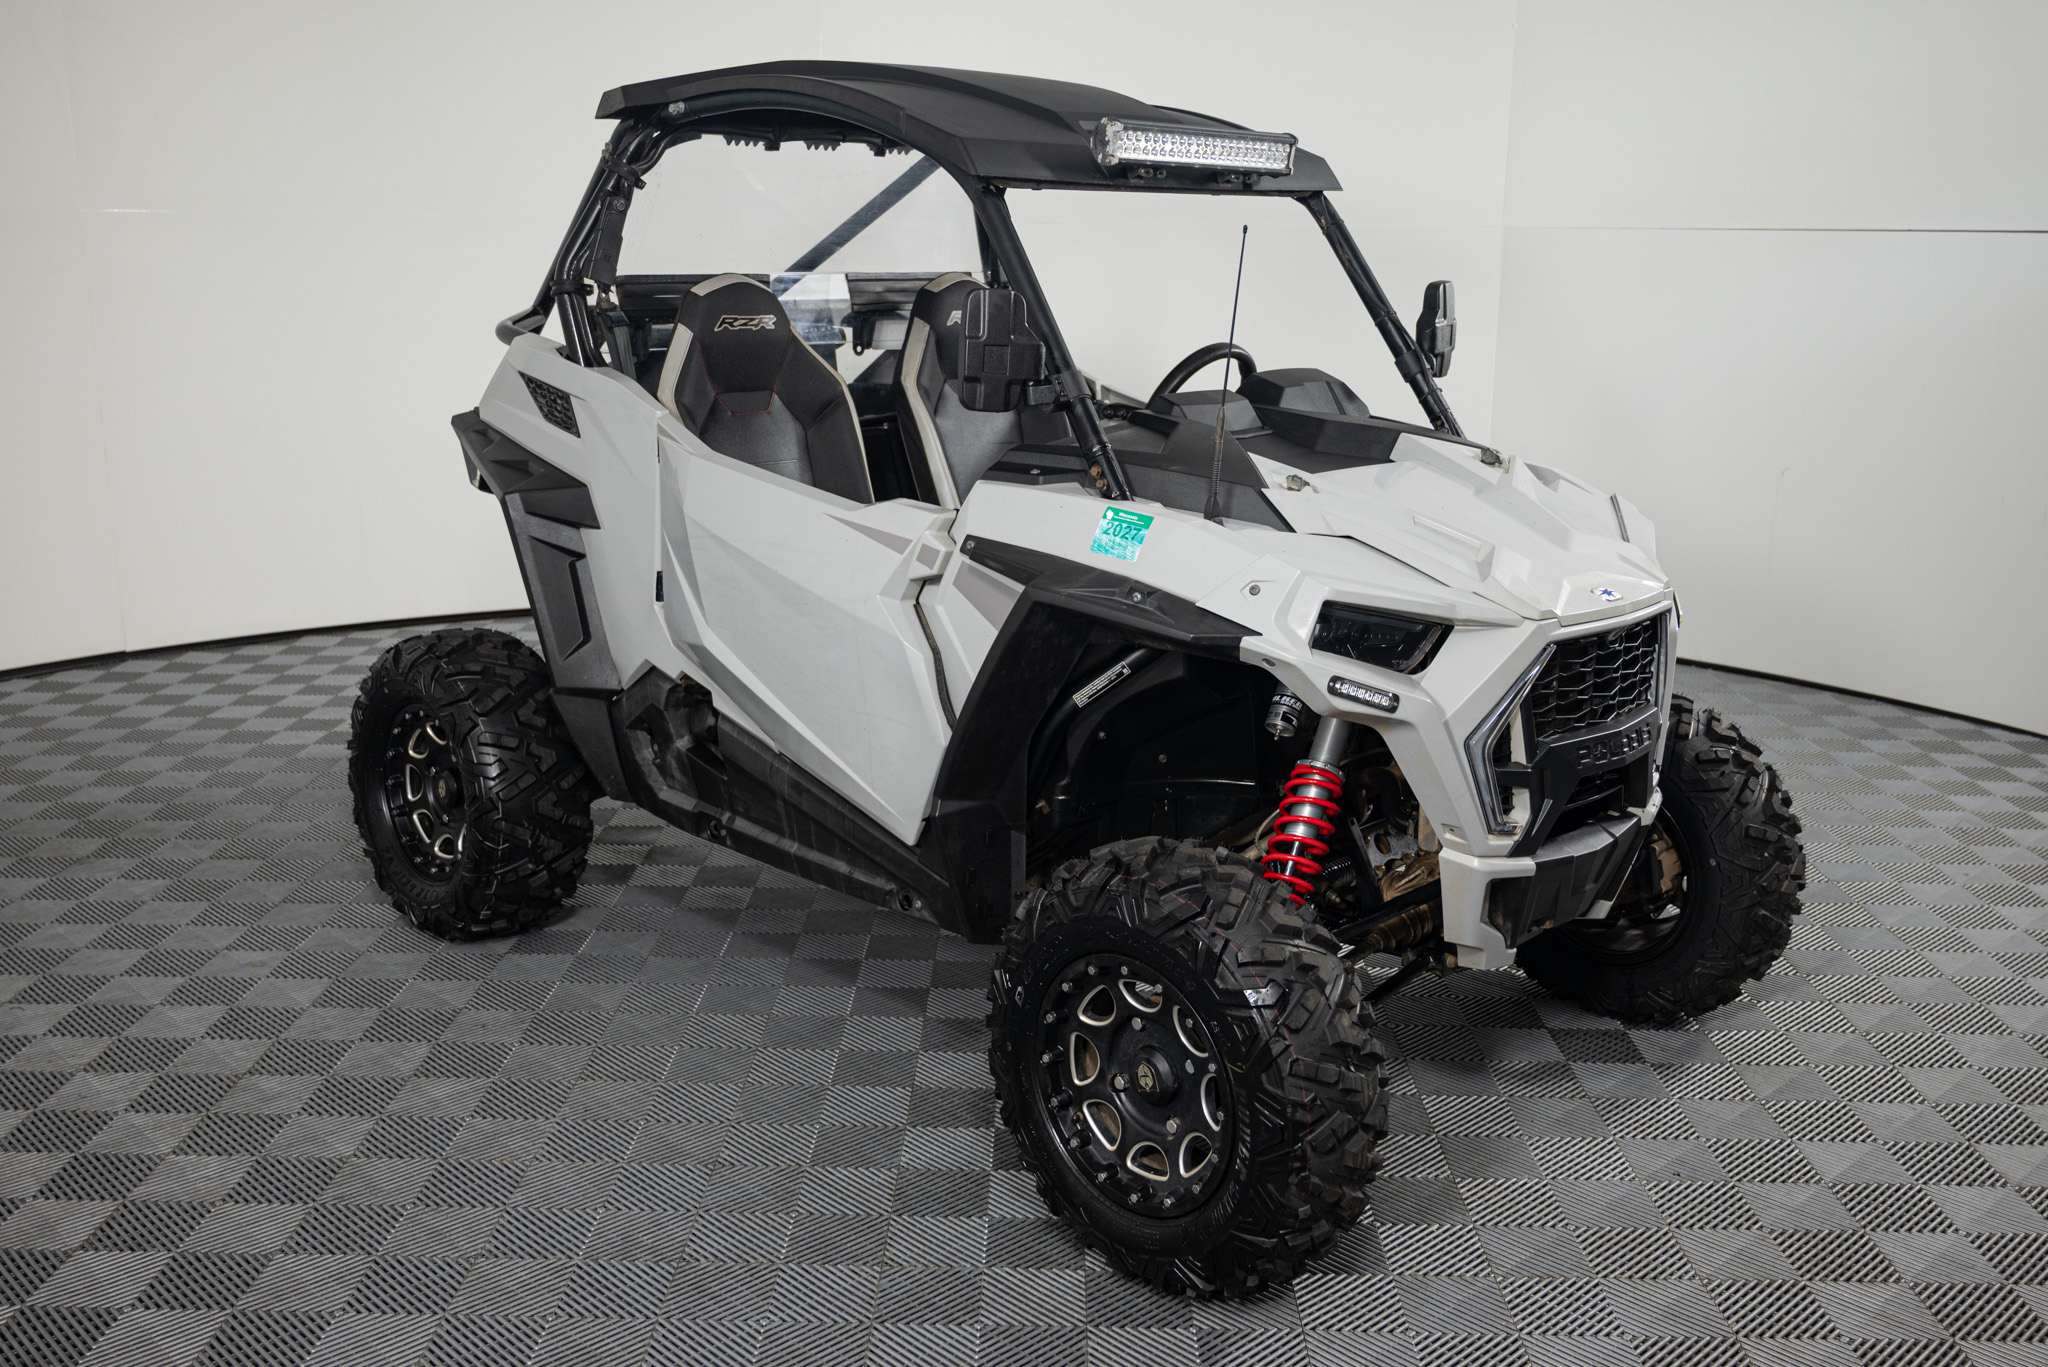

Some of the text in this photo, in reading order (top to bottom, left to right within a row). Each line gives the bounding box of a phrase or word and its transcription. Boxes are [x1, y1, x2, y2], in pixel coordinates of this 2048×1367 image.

[714, 315, 776, 331] RZR
[1103, 521, 1142, 541] 2027
[1576, 722, 1652, 769] POLARIS
